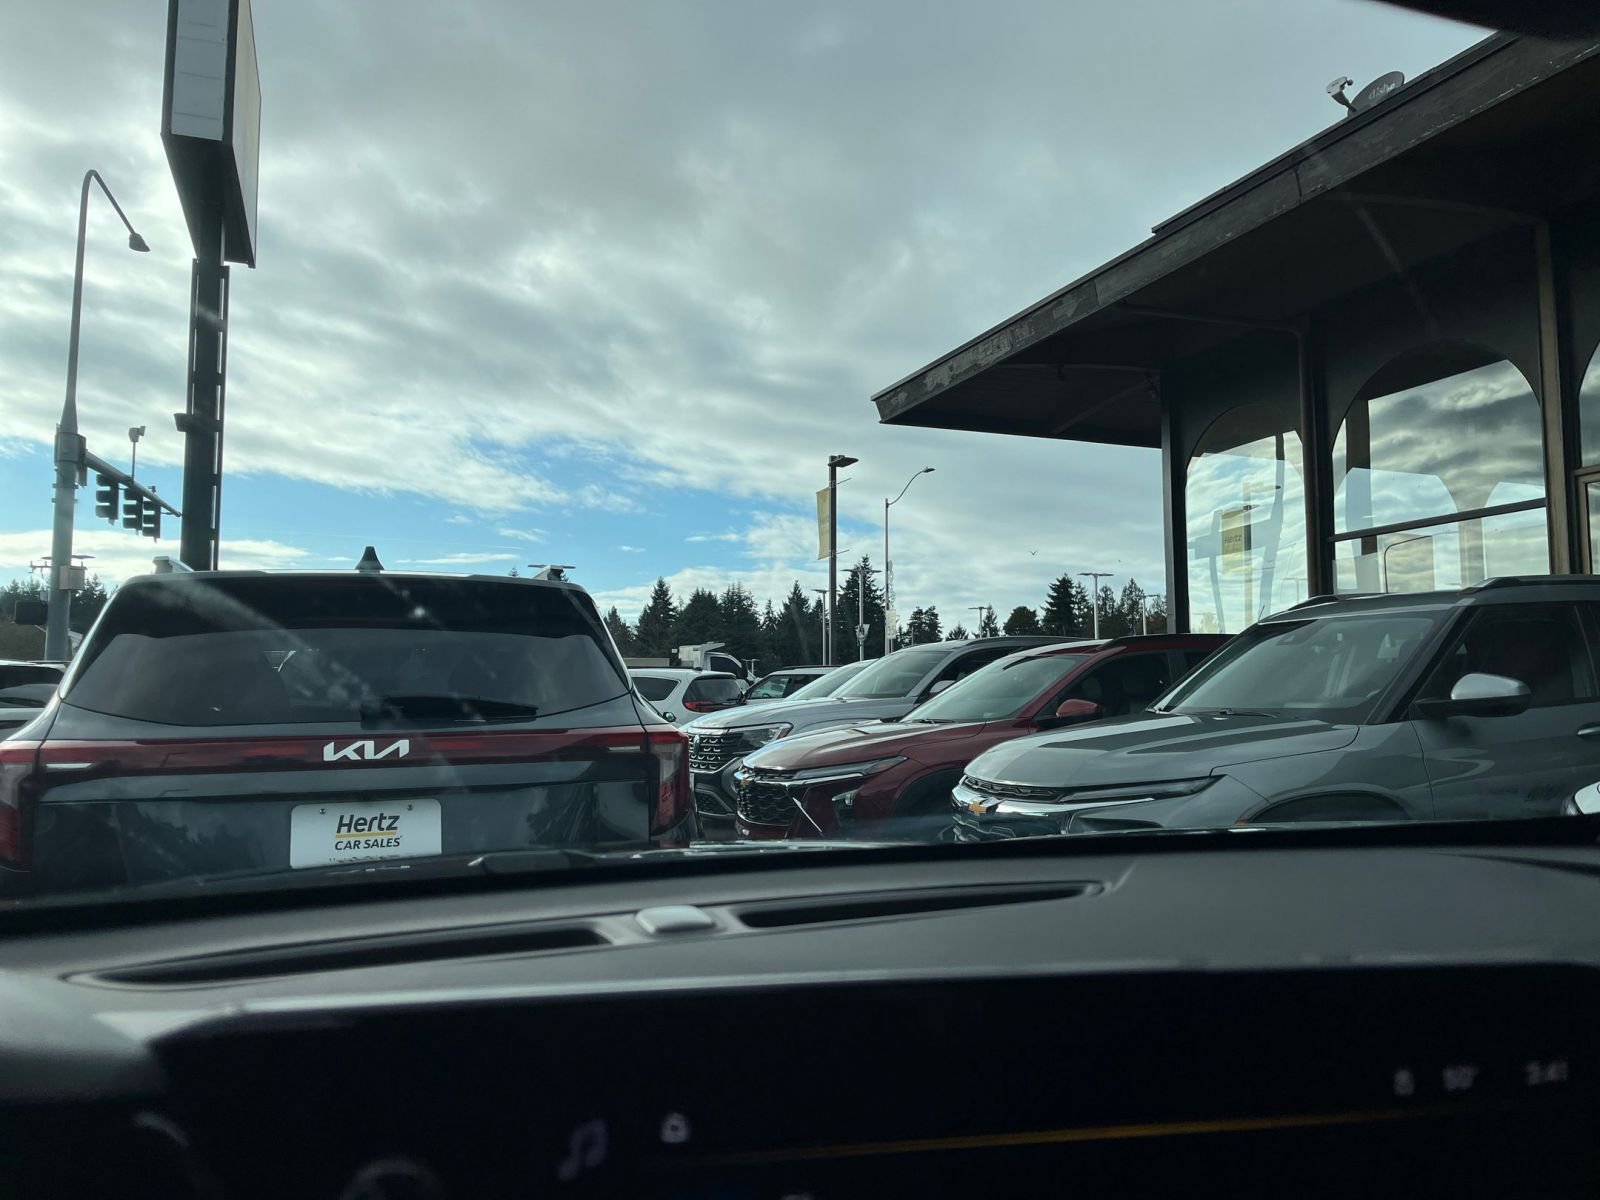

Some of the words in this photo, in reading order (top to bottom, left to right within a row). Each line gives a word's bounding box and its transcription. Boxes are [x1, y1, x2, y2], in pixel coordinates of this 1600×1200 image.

[323, 739, 410, 762] KIA
[336, 812, 401, 834] Hertz
[335, 839, 361, 851] CAR
[364, 836, 401, 849] SALES
